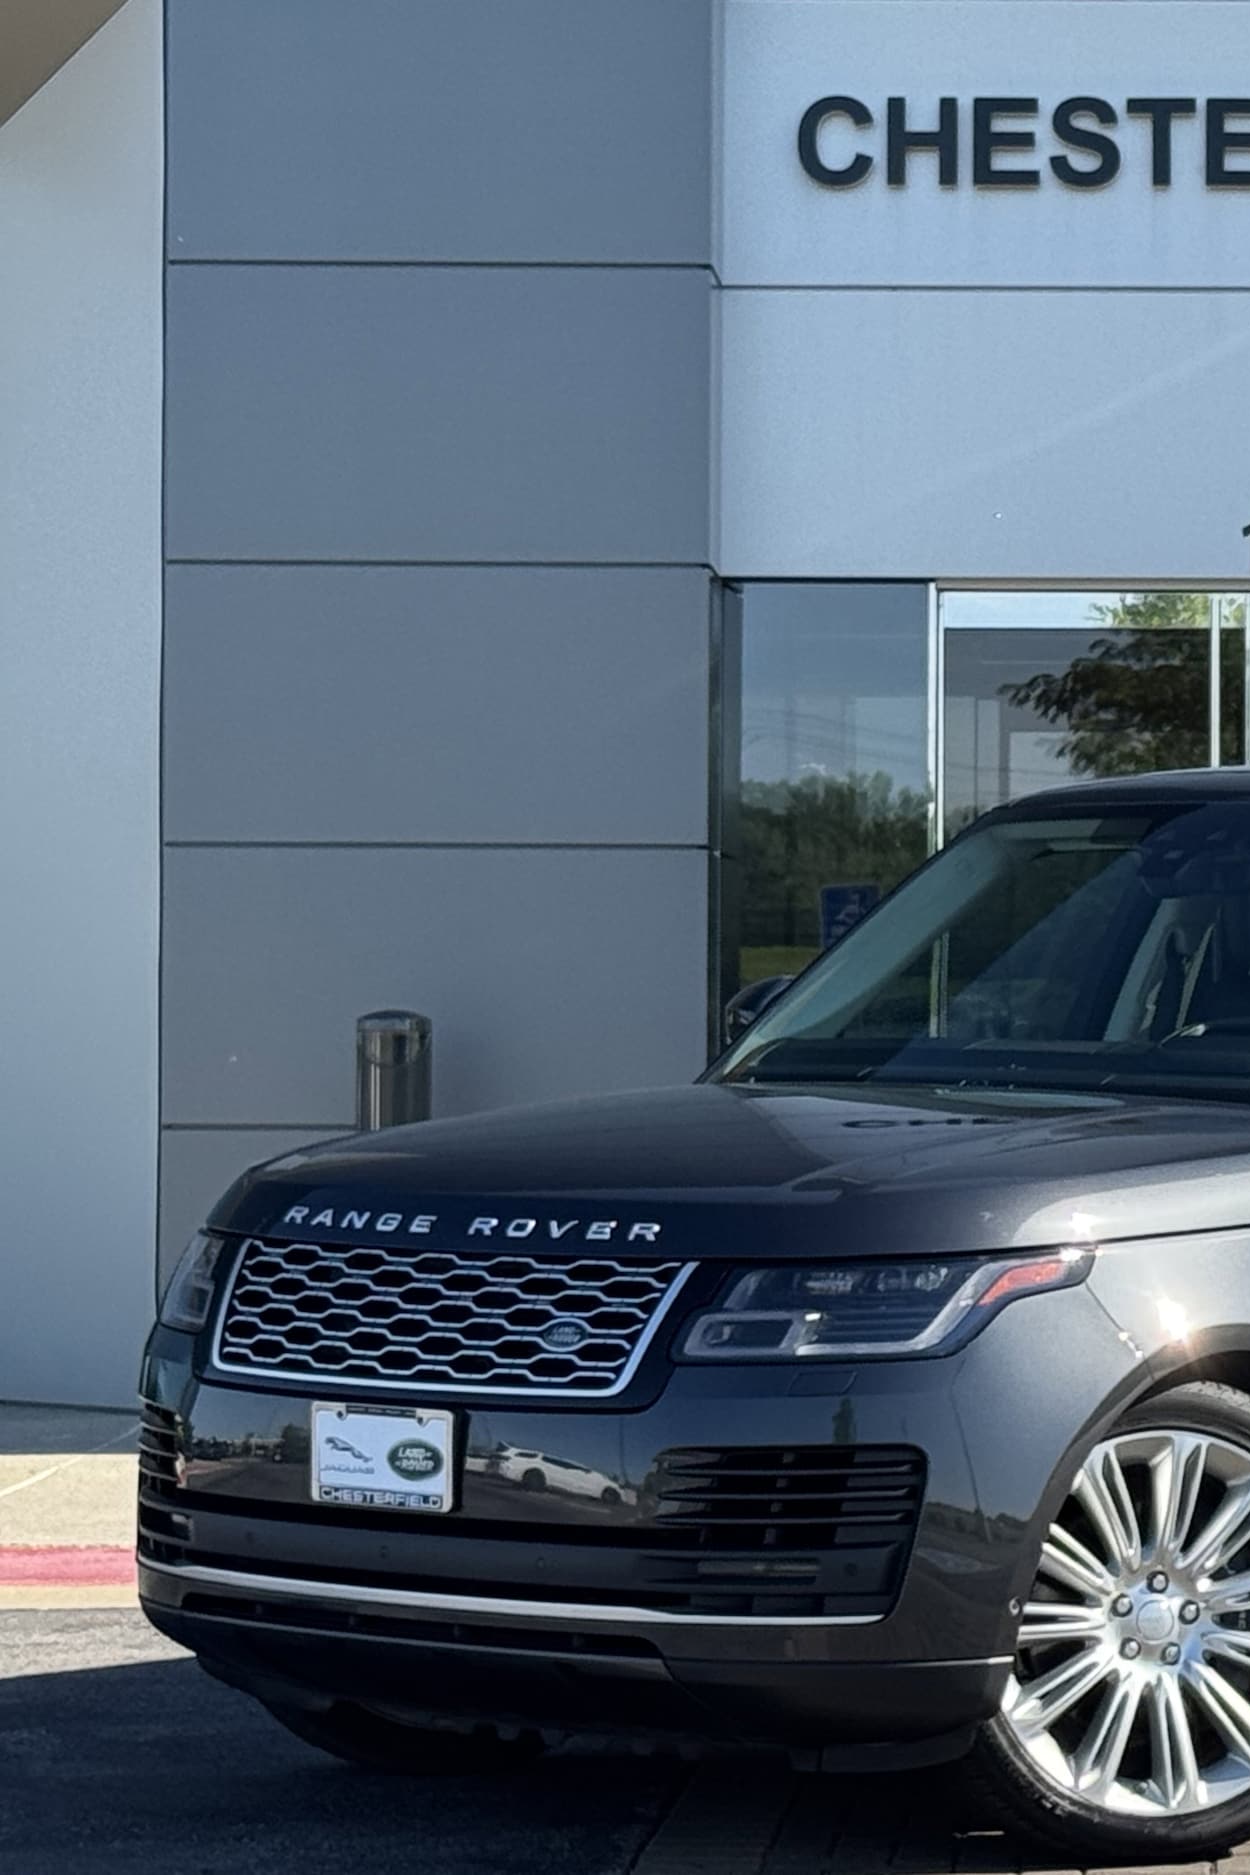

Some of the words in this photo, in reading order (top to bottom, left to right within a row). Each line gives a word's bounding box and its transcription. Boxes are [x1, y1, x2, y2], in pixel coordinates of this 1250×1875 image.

[283, 1205, 438, 1234] RANGE
[466, 1216, 662, 1242] ROVER
[321, 1486, 441, 1509] CHESTERFIELD
